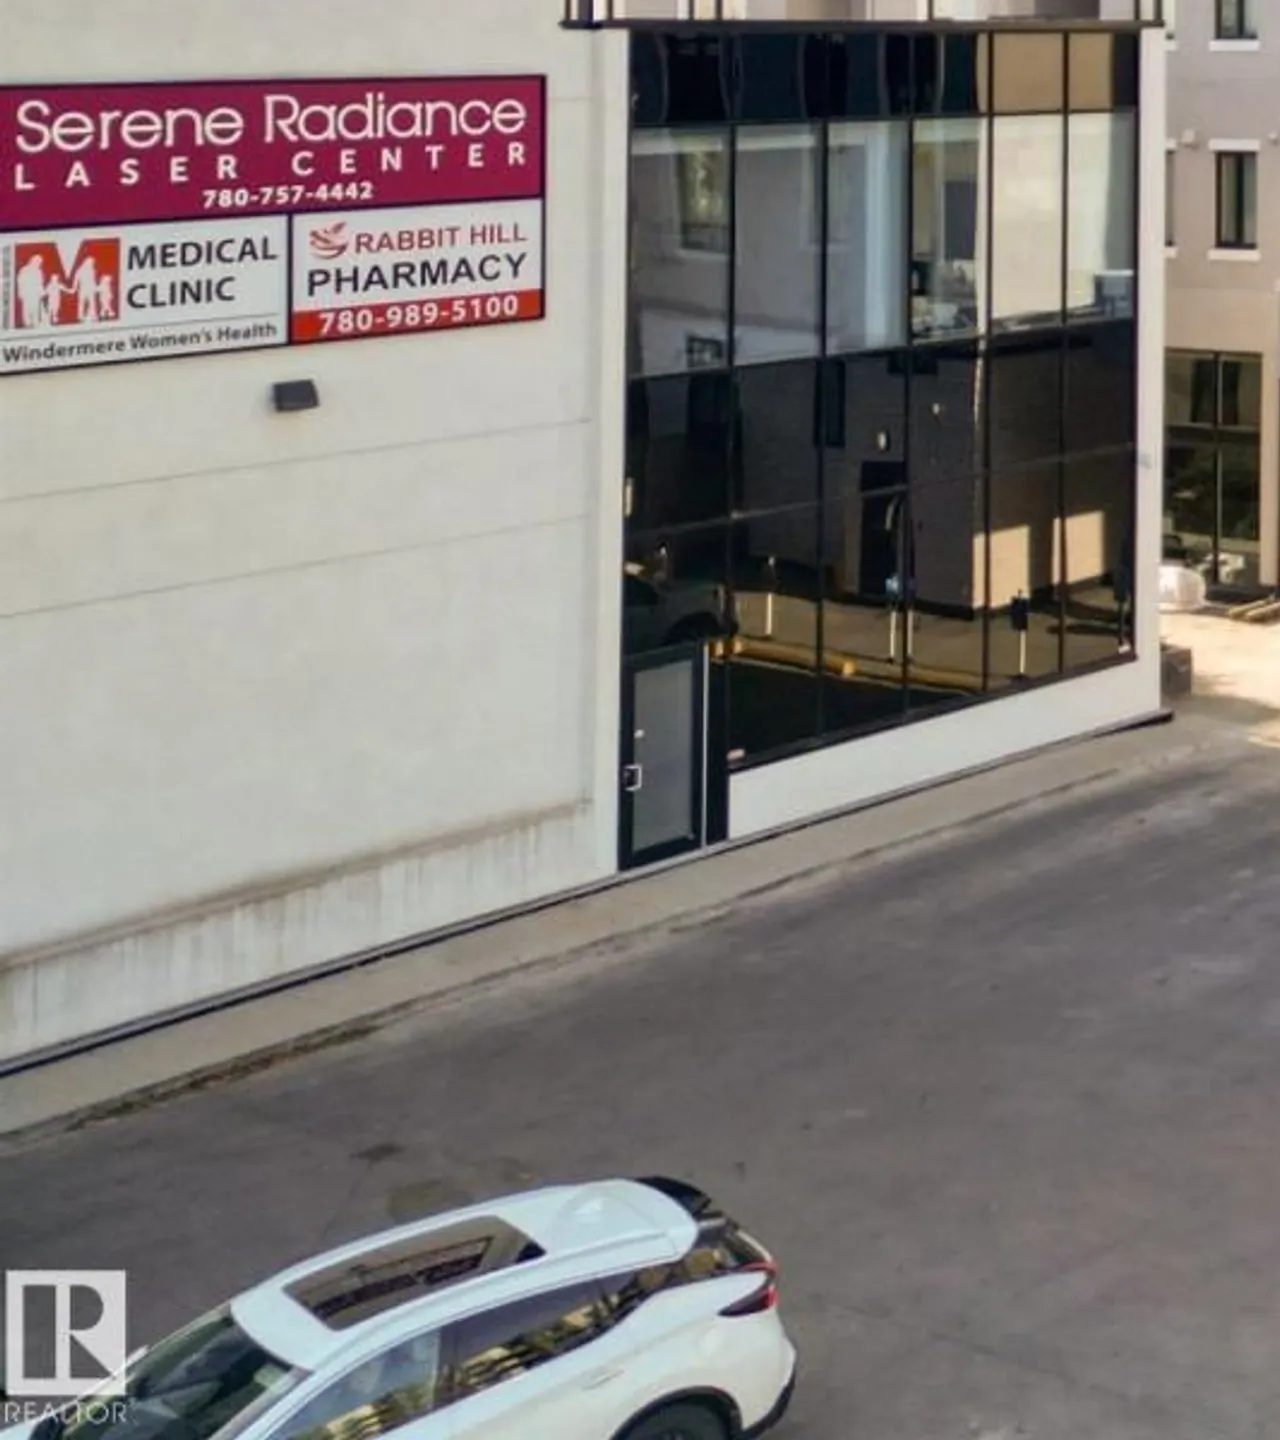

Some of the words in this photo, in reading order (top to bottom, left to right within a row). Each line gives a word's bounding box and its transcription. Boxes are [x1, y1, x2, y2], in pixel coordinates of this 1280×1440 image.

[16, 100, 244, 152] Serene
[264, 92, 526, 143] Radiance
[15, 155, 238, 190] LASER
[291, 142, 525, 176] CENTER
[203, 181, 373, 209] 780-757-4442
[127, 236, 277, 271] MEDICAL
[355, 226, 461, 254] RABBIT
[470, 223, 527, 246] HILL
[127, 276, 235, 309] CLINIC
[307, 252, 527, 297] PHARMACY
[319, 295, 519, 335] 780-989-5100
[2, 342, 125, 363] Windermere
[130, 327, 213, 350] Women's
[218, 322, 278, 343] Health
